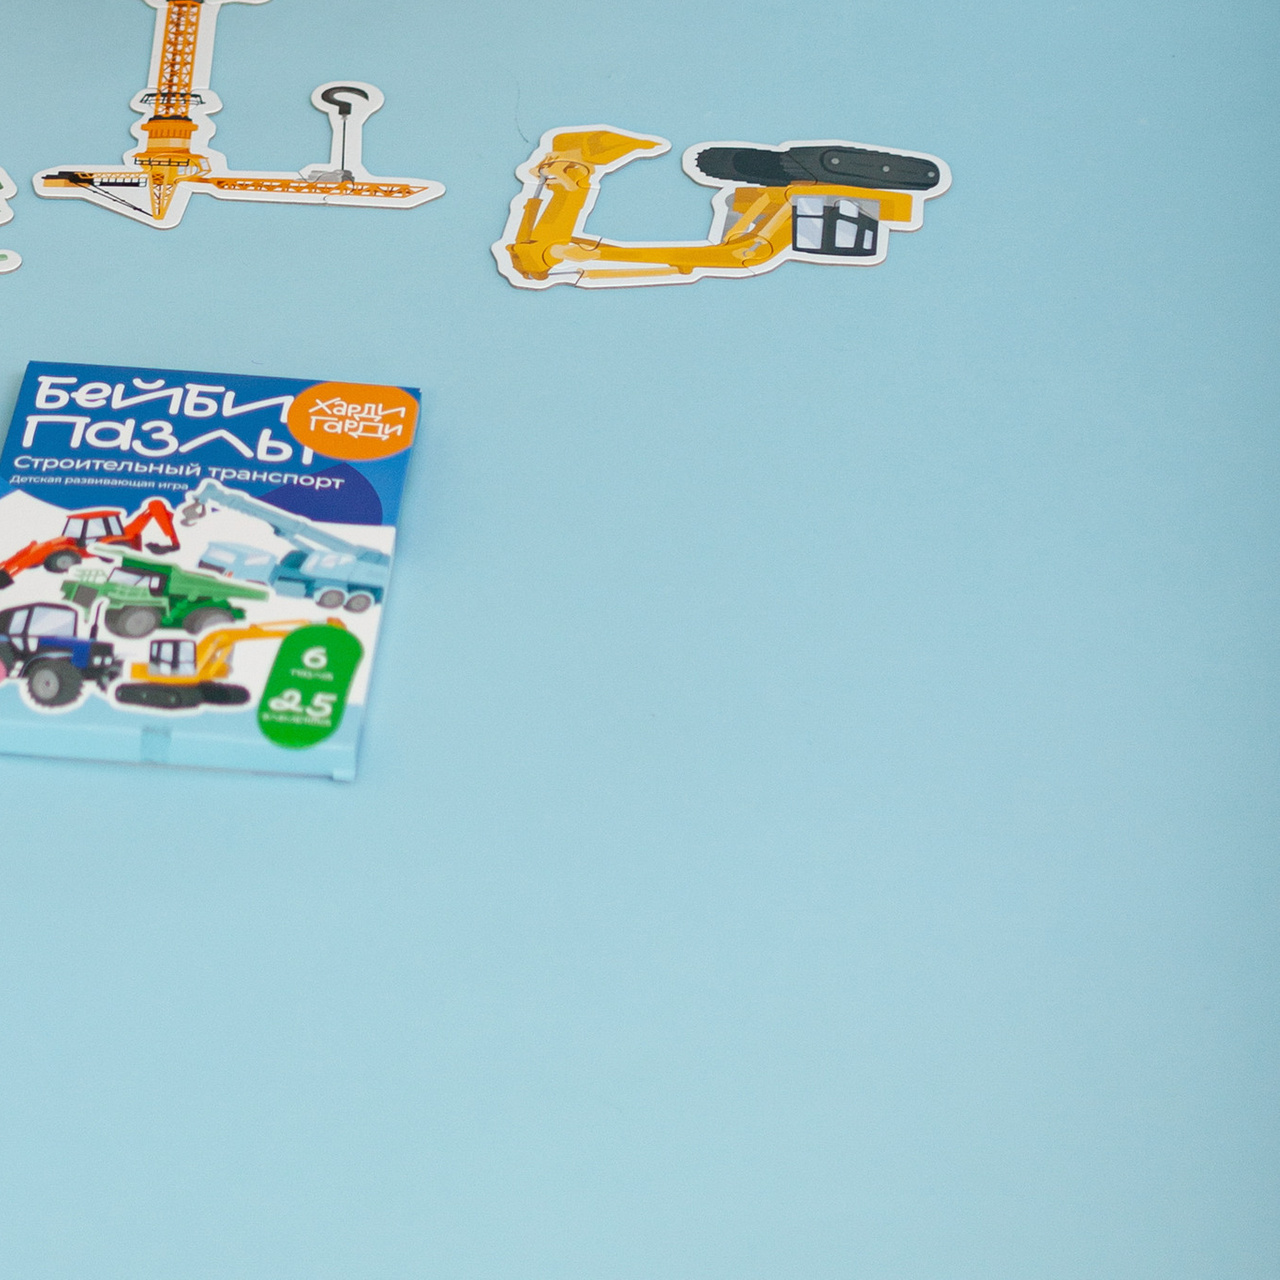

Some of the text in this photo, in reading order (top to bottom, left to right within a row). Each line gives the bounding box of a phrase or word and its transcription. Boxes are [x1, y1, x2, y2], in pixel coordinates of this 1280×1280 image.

[9, 474, 189, 491] Детская развивающая игра
[13, 455, 345, 490] Строительный транспорт
[302, 646, 328, 670] 6
